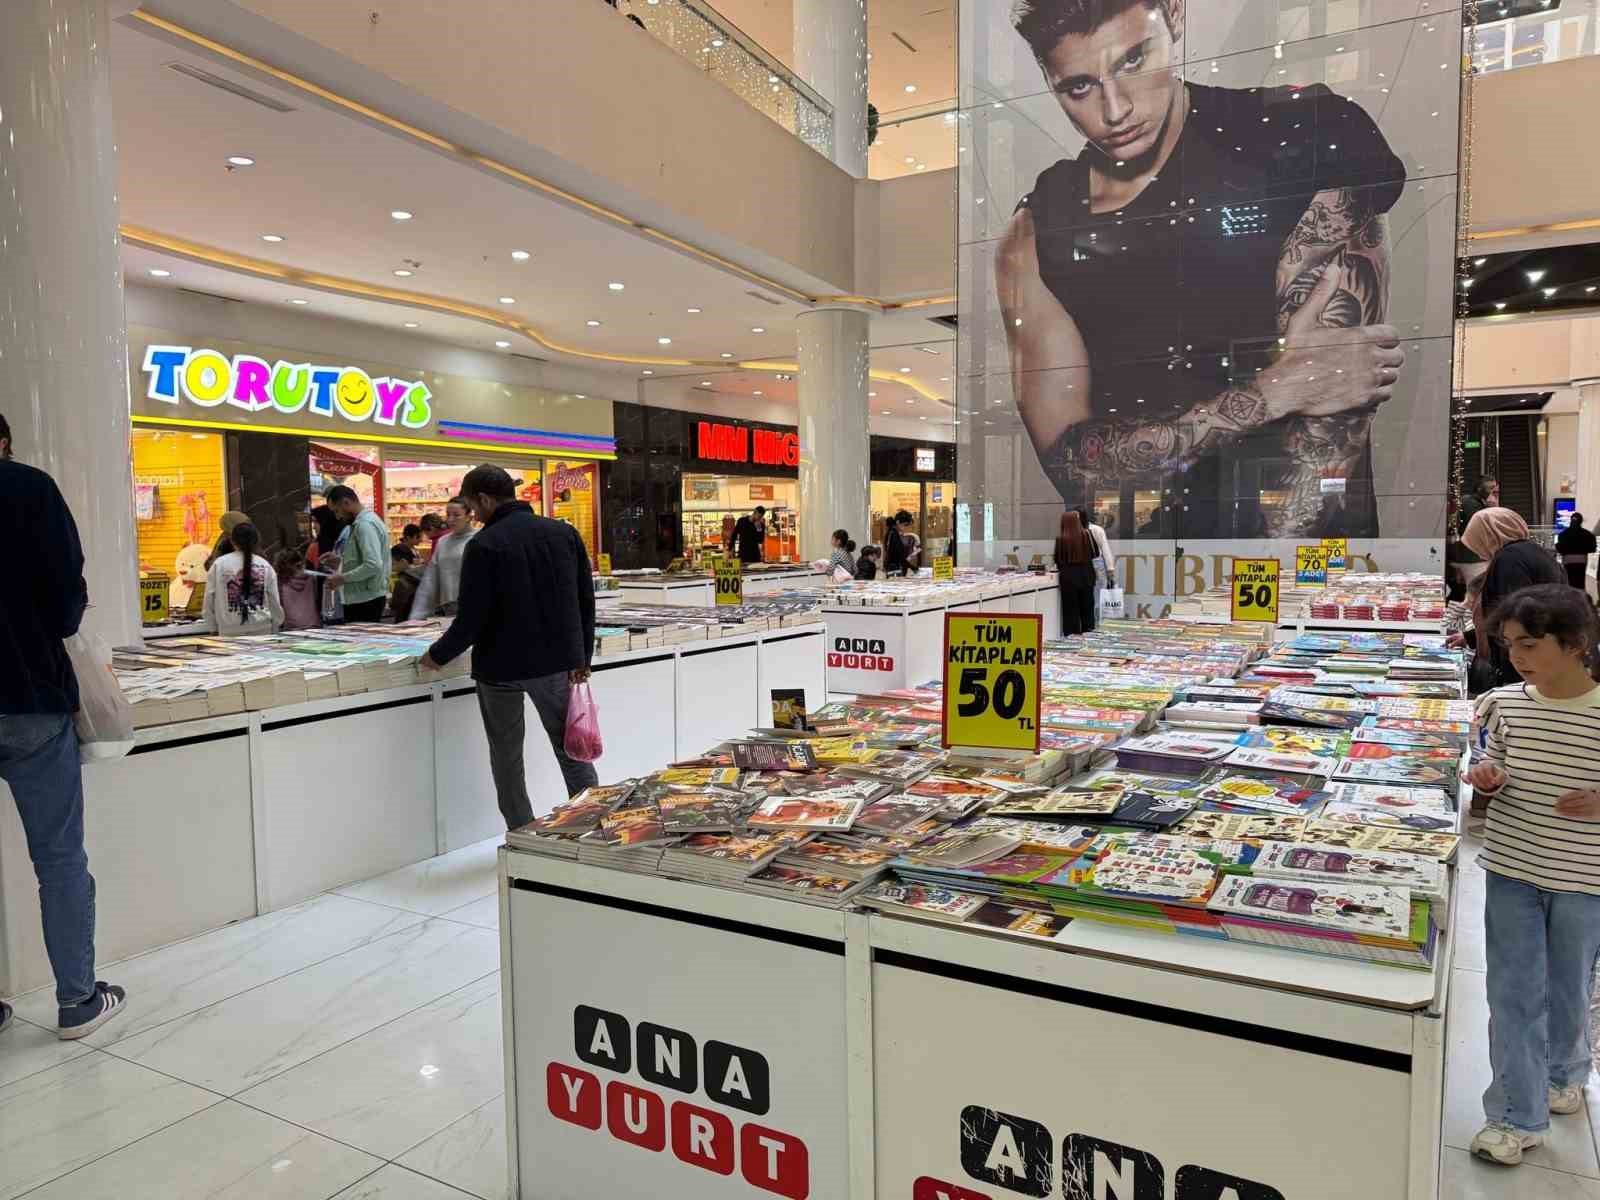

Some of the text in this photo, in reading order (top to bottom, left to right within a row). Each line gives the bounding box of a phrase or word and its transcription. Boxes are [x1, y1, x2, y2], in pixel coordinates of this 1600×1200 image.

[143, 345, 432, 427] TORUTOYS
[1247, 562, 1266, 573] TÜM
[1303, 560, 1321, 570] 70
[716, 577, 740, 594] 100
[1234, 571, 1277, 583] KİTAPLAR
[144, 595, 162, 611] 15
[1238, 584, 1272, 608] 50
[974, 620, 1012, 643] TÜM
[837, 638, 883, 653] ANA
[949, 640, 1037, 665] KİTAPLAR
[829, 654, 891, 670] YURT
[957, 668, 1034, 730] 50 TL
[584, 1013, 759, 1106] ANA
[555, 1069, 794, 1187] YURT
[978, 1118, 1256, 1200] AN
